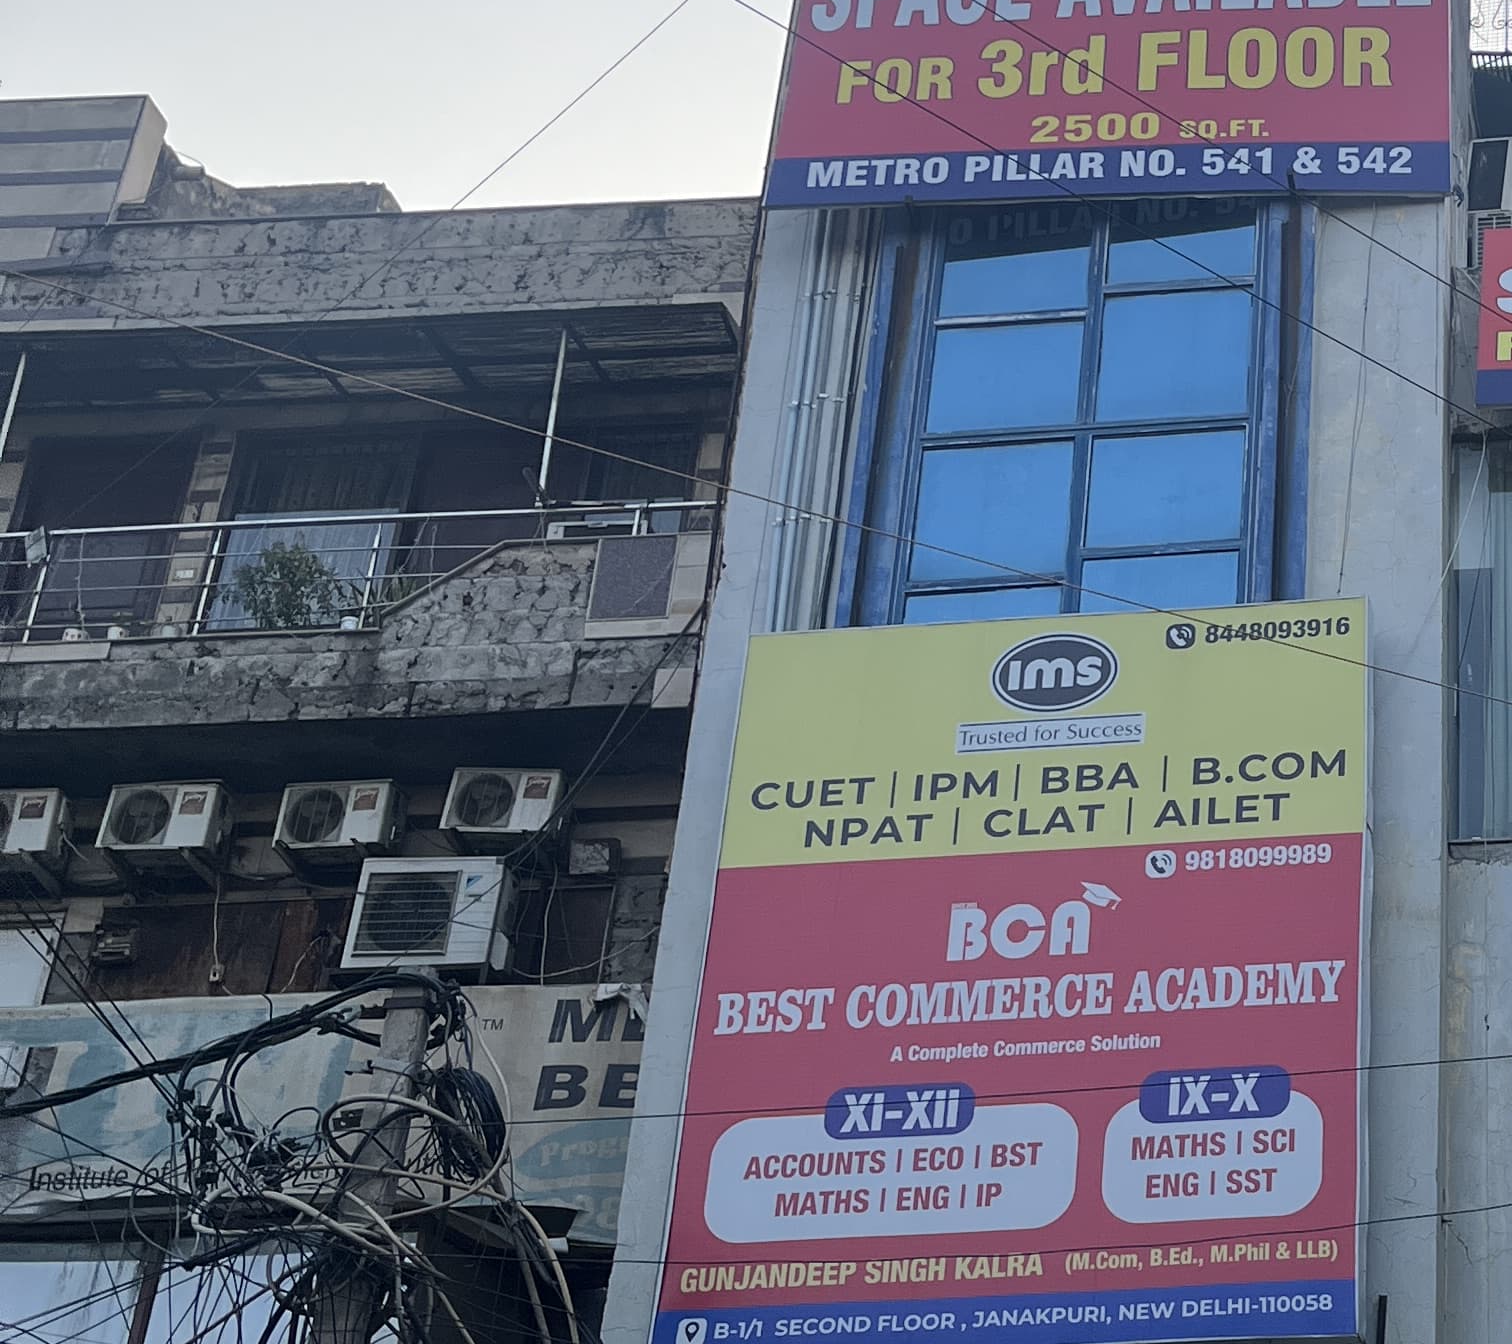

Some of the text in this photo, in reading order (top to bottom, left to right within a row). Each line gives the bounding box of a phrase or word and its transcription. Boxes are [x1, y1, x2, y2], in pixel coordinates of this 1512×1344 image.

[836, 26, 1393, 104] FOR 3rd FLOOR
[1029, 112, 1270, 143] 2500 SQ.FT.
[806, 147, 1412, 188] METRO PILLAR NO. 541 & 542
[1204, 616, 1351, 645] 8448093916
[960, 721, 1142, 747] Trusted for Success
[751, 750, 1347, 811] CUET IPM BBA B.COM
[803, 794, 1291, 849] NPAT CLAT AILET
[1185, 845, 1332, 872] 9818099989
[946, 899, 1092, 962] BCA
[713, 960, 1346, 1037] BEST COMMERCE ACADEMY
[891, 1032, 1161, 1064] A Complete Commerce Solution
[839, 1090, 961, 1132] XI-XII
[1168, 1072, 1260, 1116] IX-X
[743, 1142, 1042, 1181] ACCOUNTS ECO BST
[1130, 1129, 1296, 1161] MATHS SCI
[774, 1183, 1003, 1218] MATHS ENG IP
[1145, 1169, 1277, 1199] ENG SST
[680, 1253, 1043, 1293] GUNJANDEEP SINGH KALRA
